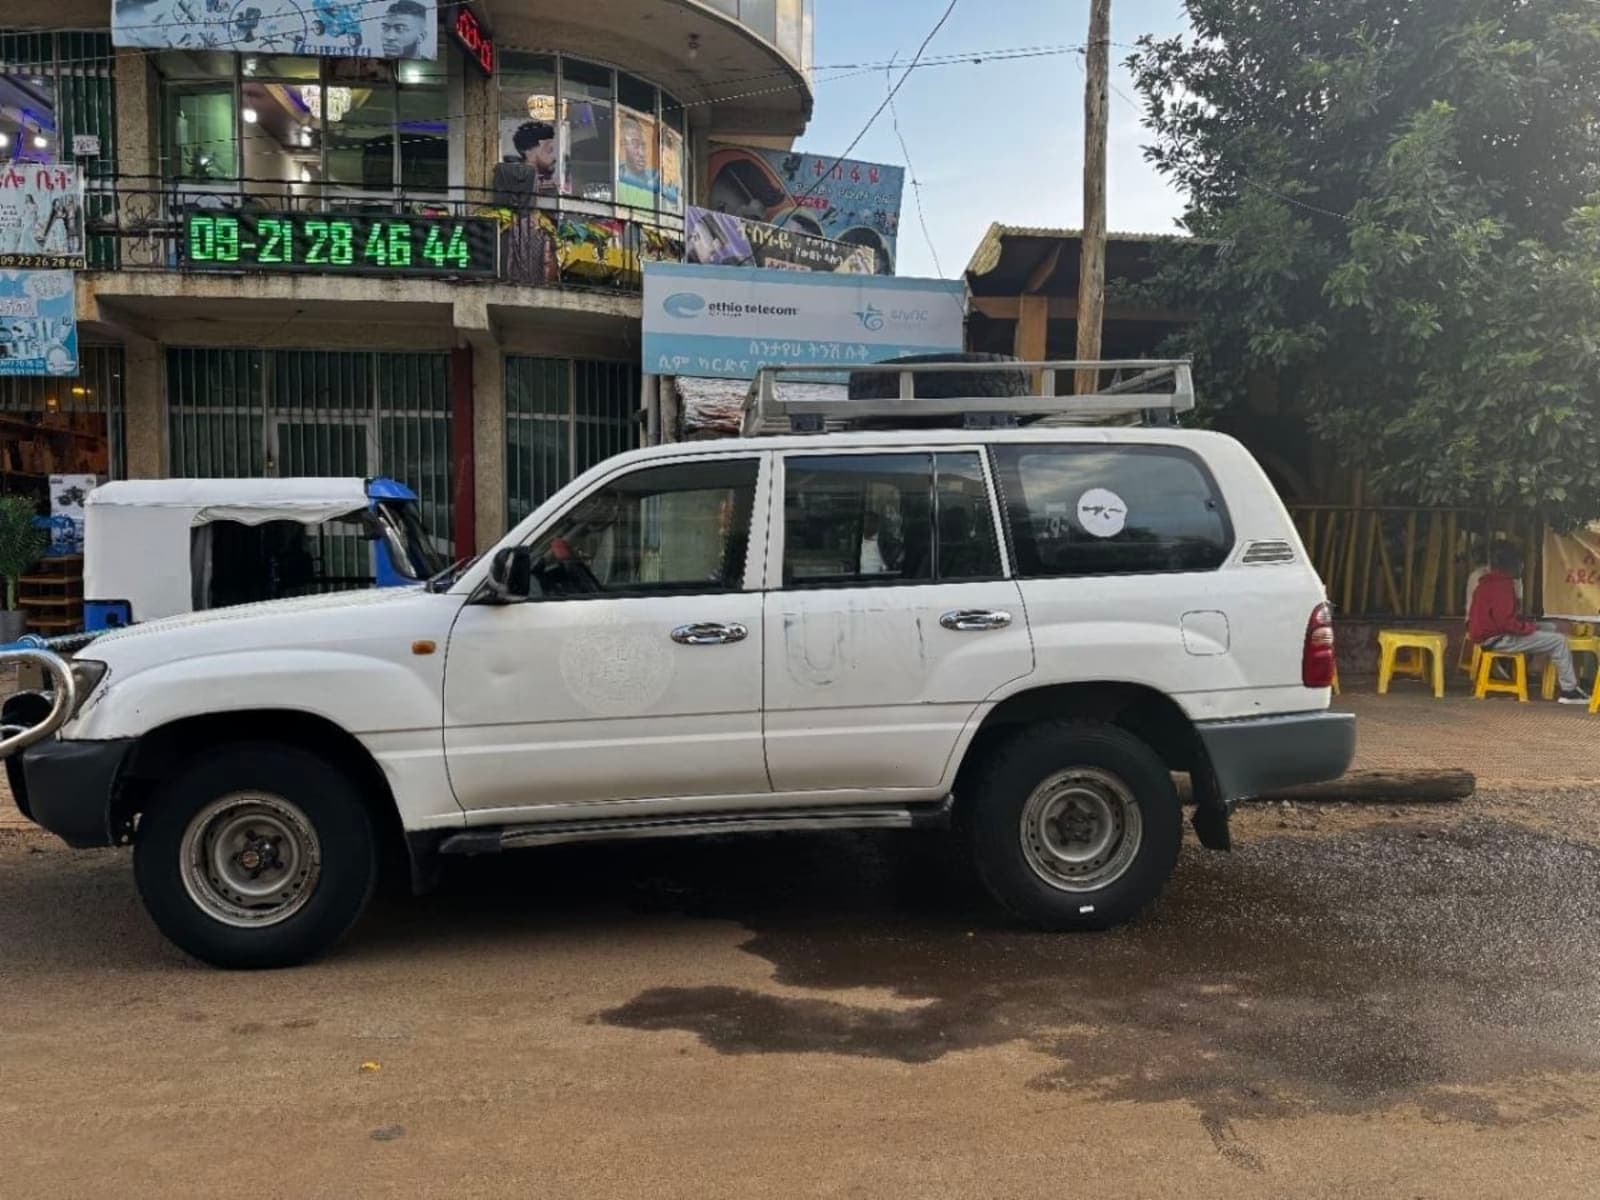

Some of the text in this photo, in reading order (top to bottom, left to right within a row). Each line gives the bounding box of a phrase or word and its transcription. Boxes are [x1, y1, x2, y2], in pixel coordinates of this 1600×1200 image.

[0, 168, 25, 188] ሎ
[191, 218, 470, 268] 09-21 28 46 44
[708, 302, 743, 313] ethio
[745, 303, 797, 316] telecom
